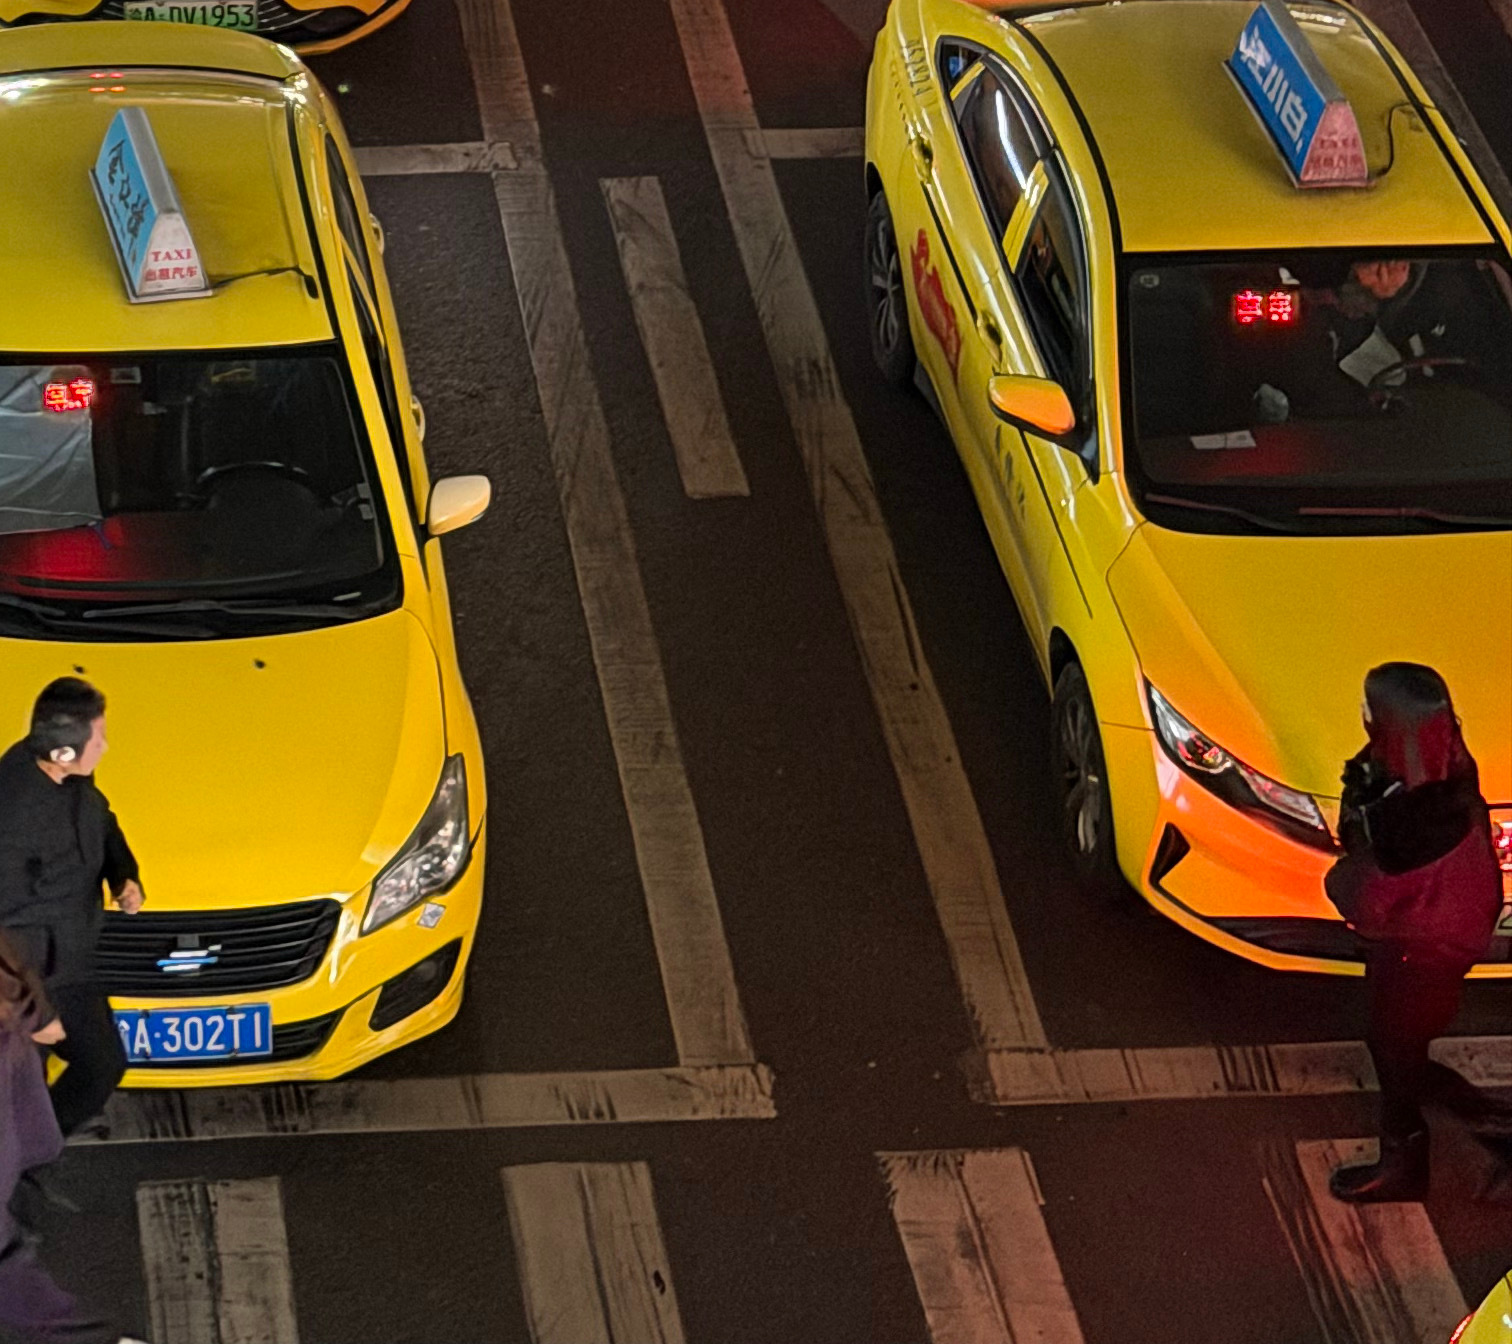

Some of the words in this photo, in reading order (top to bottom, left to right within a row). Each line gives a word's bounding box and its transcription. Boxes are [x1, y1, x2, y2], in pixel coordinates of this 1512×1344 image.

[168, 4, 254, 28] DV1953
[151, 248, 192, 263] TAXI
[144, 264, 199, 283] 出租汽车
